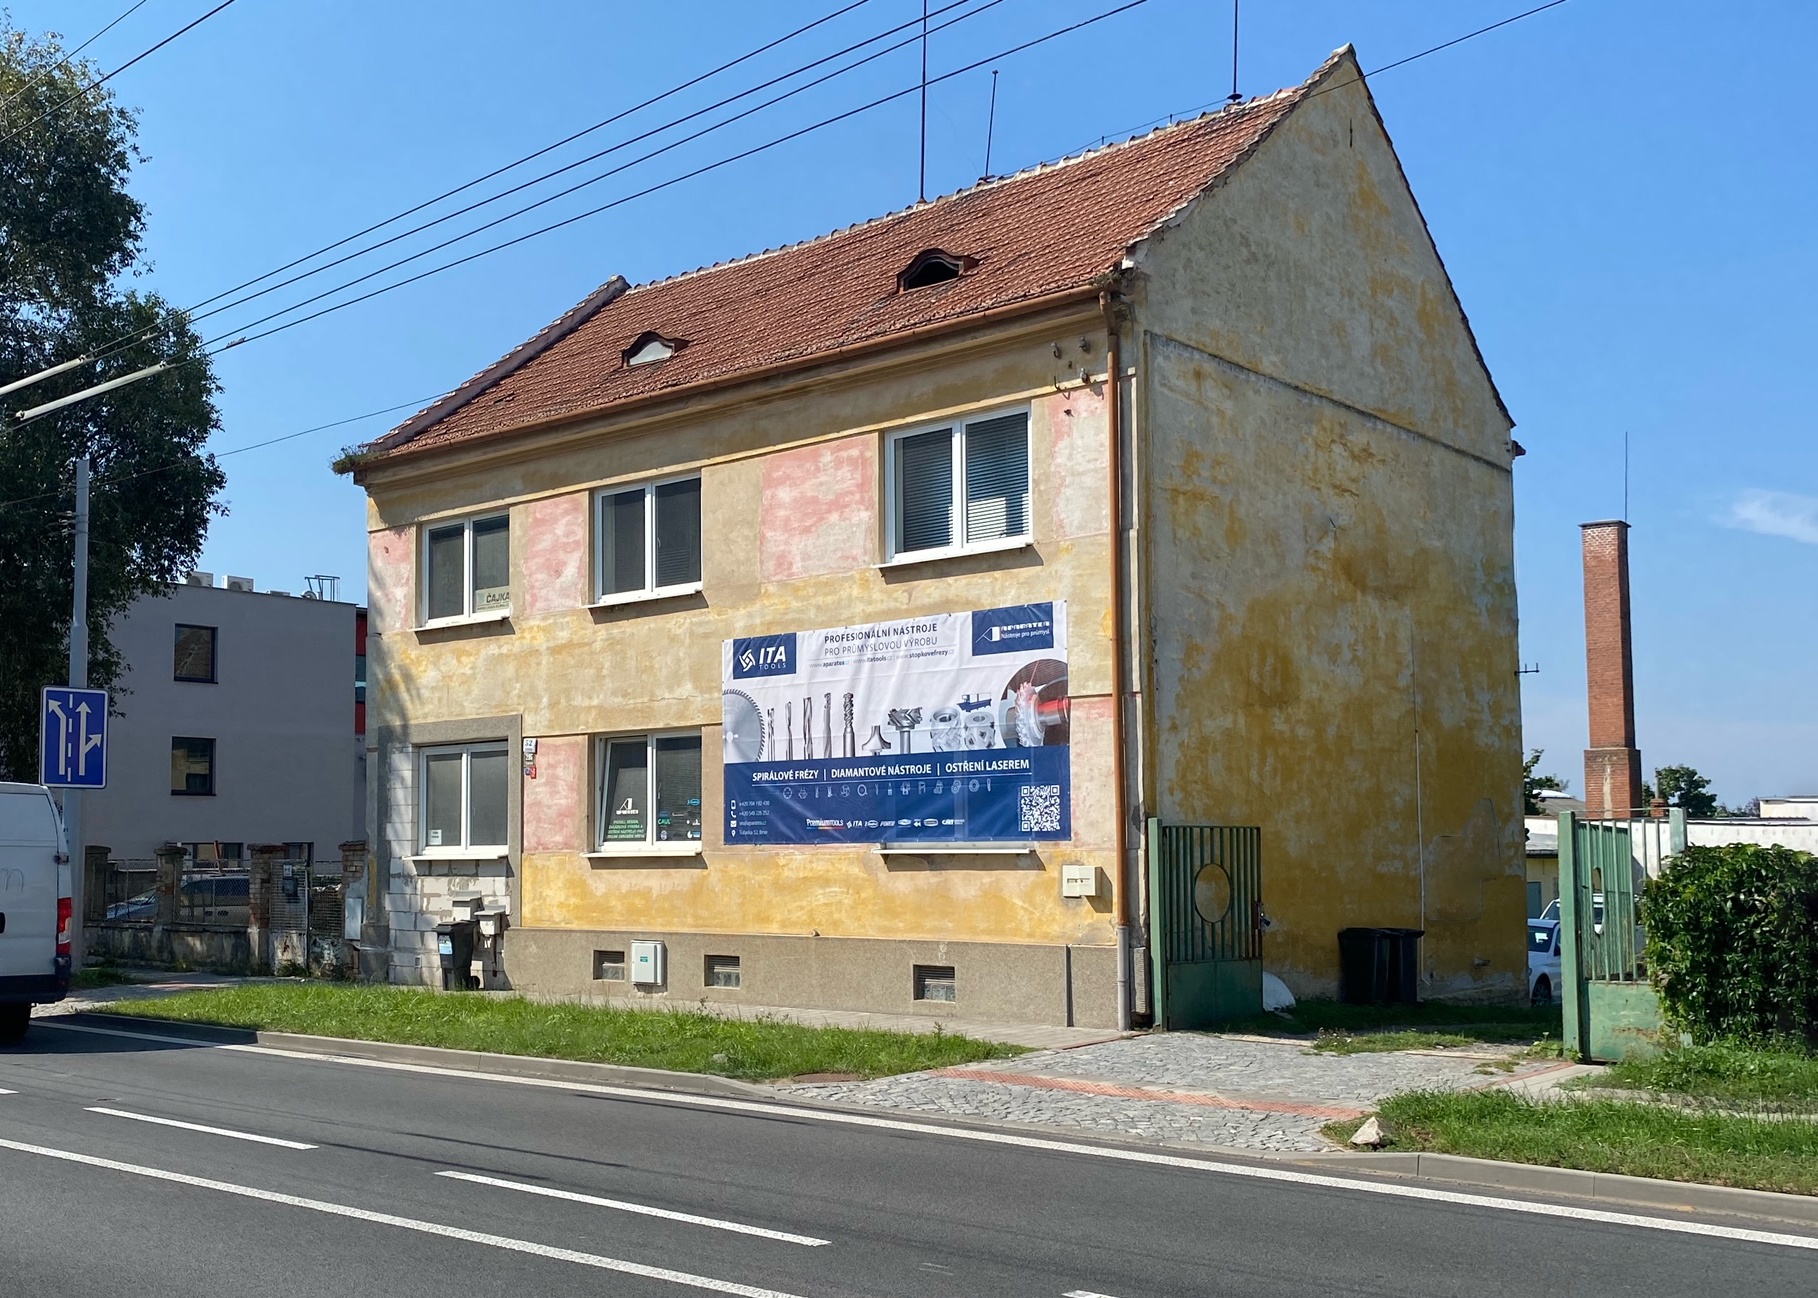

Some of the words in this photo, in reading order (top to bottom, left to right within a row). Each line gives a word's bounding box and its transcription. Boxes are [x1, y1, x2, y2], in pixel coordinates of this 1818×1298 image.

[824, 627, 891, 644] PROFESIONÁLNÍ
[893, 623, 938, 636] NÁSTROJE
[1031, 629, 1050, 637] průmysl
[759, 646, 786, 664] ITA
[824, 646, 840, 657] PRO
[842, 641, 902, 655] PRŮMYSLOVOU
[904, 636, 938, 648] VÝROBU
[759, 663, 787, 671] TOOLS
[752, 770, 794, 782] SPIRÁLOVÉ
[795, 769, 819, 780] FRÉZY
[831, 766, 886, 779] DIAMANTOVÉ
[888, 764, 932, 776] NÁSTROJE
[945, 760, 985, 773] OSTŘENÍ
[986, 759, 1030, 771] LASEREM
